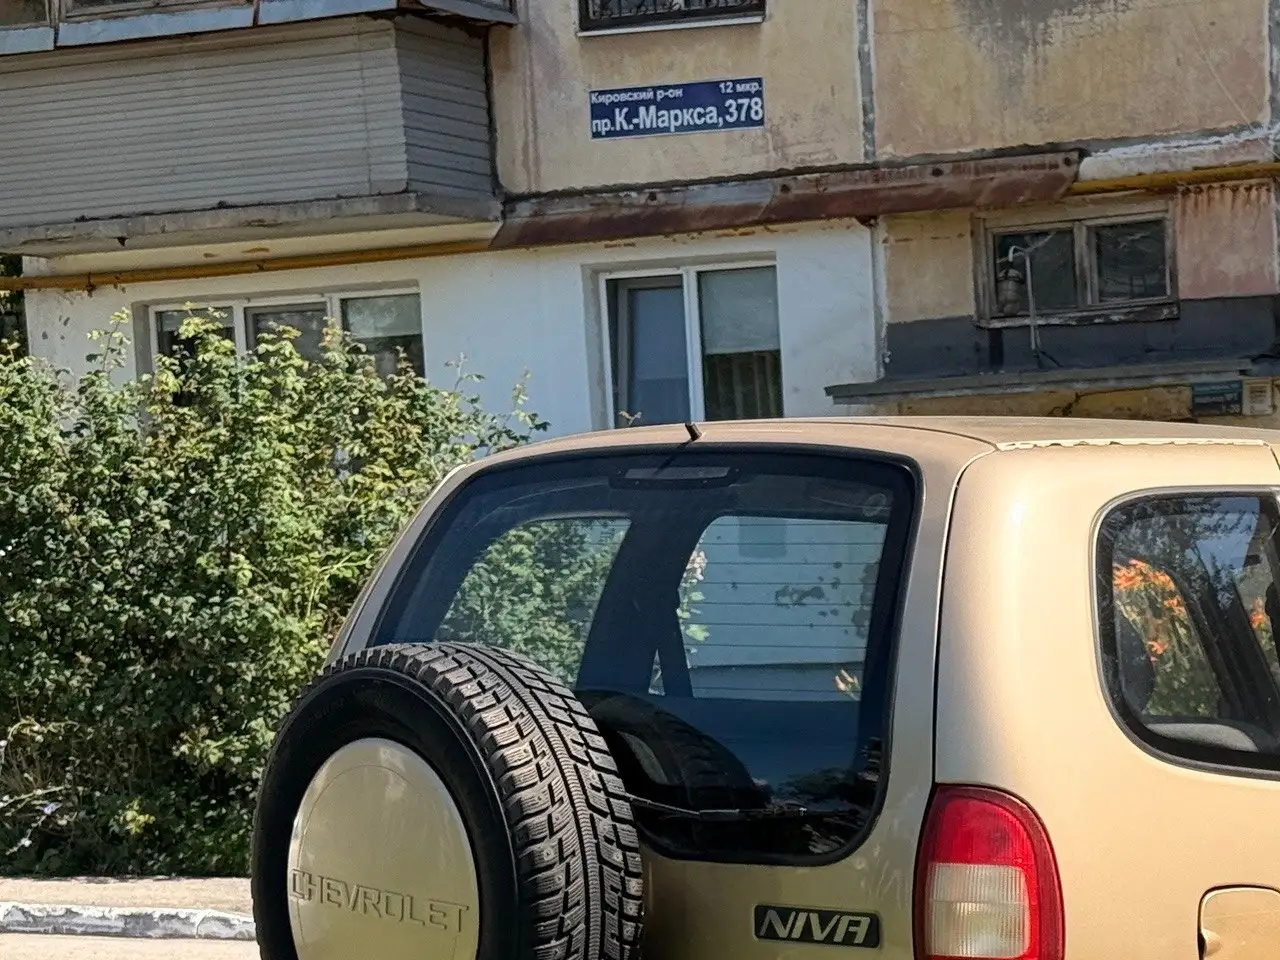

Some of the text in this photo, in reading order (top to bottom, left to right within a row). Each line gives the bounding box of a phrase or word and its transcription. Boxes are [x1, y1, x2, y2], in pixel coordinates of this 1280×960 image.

[590, 88, 684, 104] Кировский р-он
[719, 82, 732, 93] 12
[290, 868, 470, 933] CHEVROLET
[760, 909, 871, 944] NIVA
